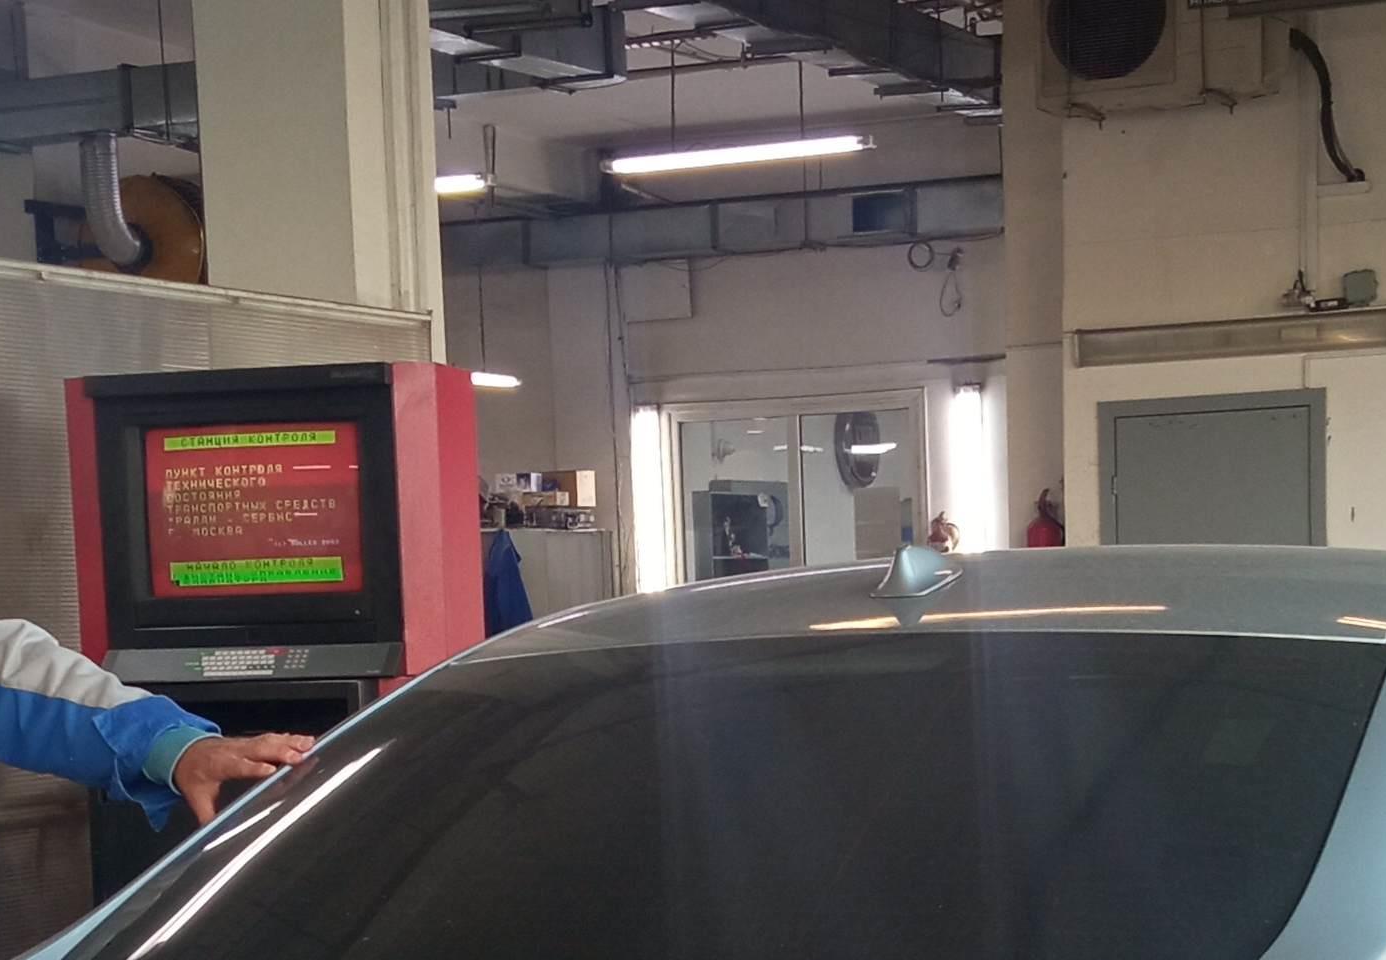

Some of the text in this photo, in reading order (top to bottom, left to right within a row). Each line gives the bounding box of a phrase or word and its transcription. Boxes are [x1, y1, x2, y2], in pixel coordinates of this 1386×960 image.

[165, 464, 282, 478] ПУНКТ КОНТРОЛЯ
[165, 477, 266, 491] ТЕХНИЧЕСКОГО
[167, 498, 336, 514] ТРАНСПОРТНЫХ СРЕДСТВ
